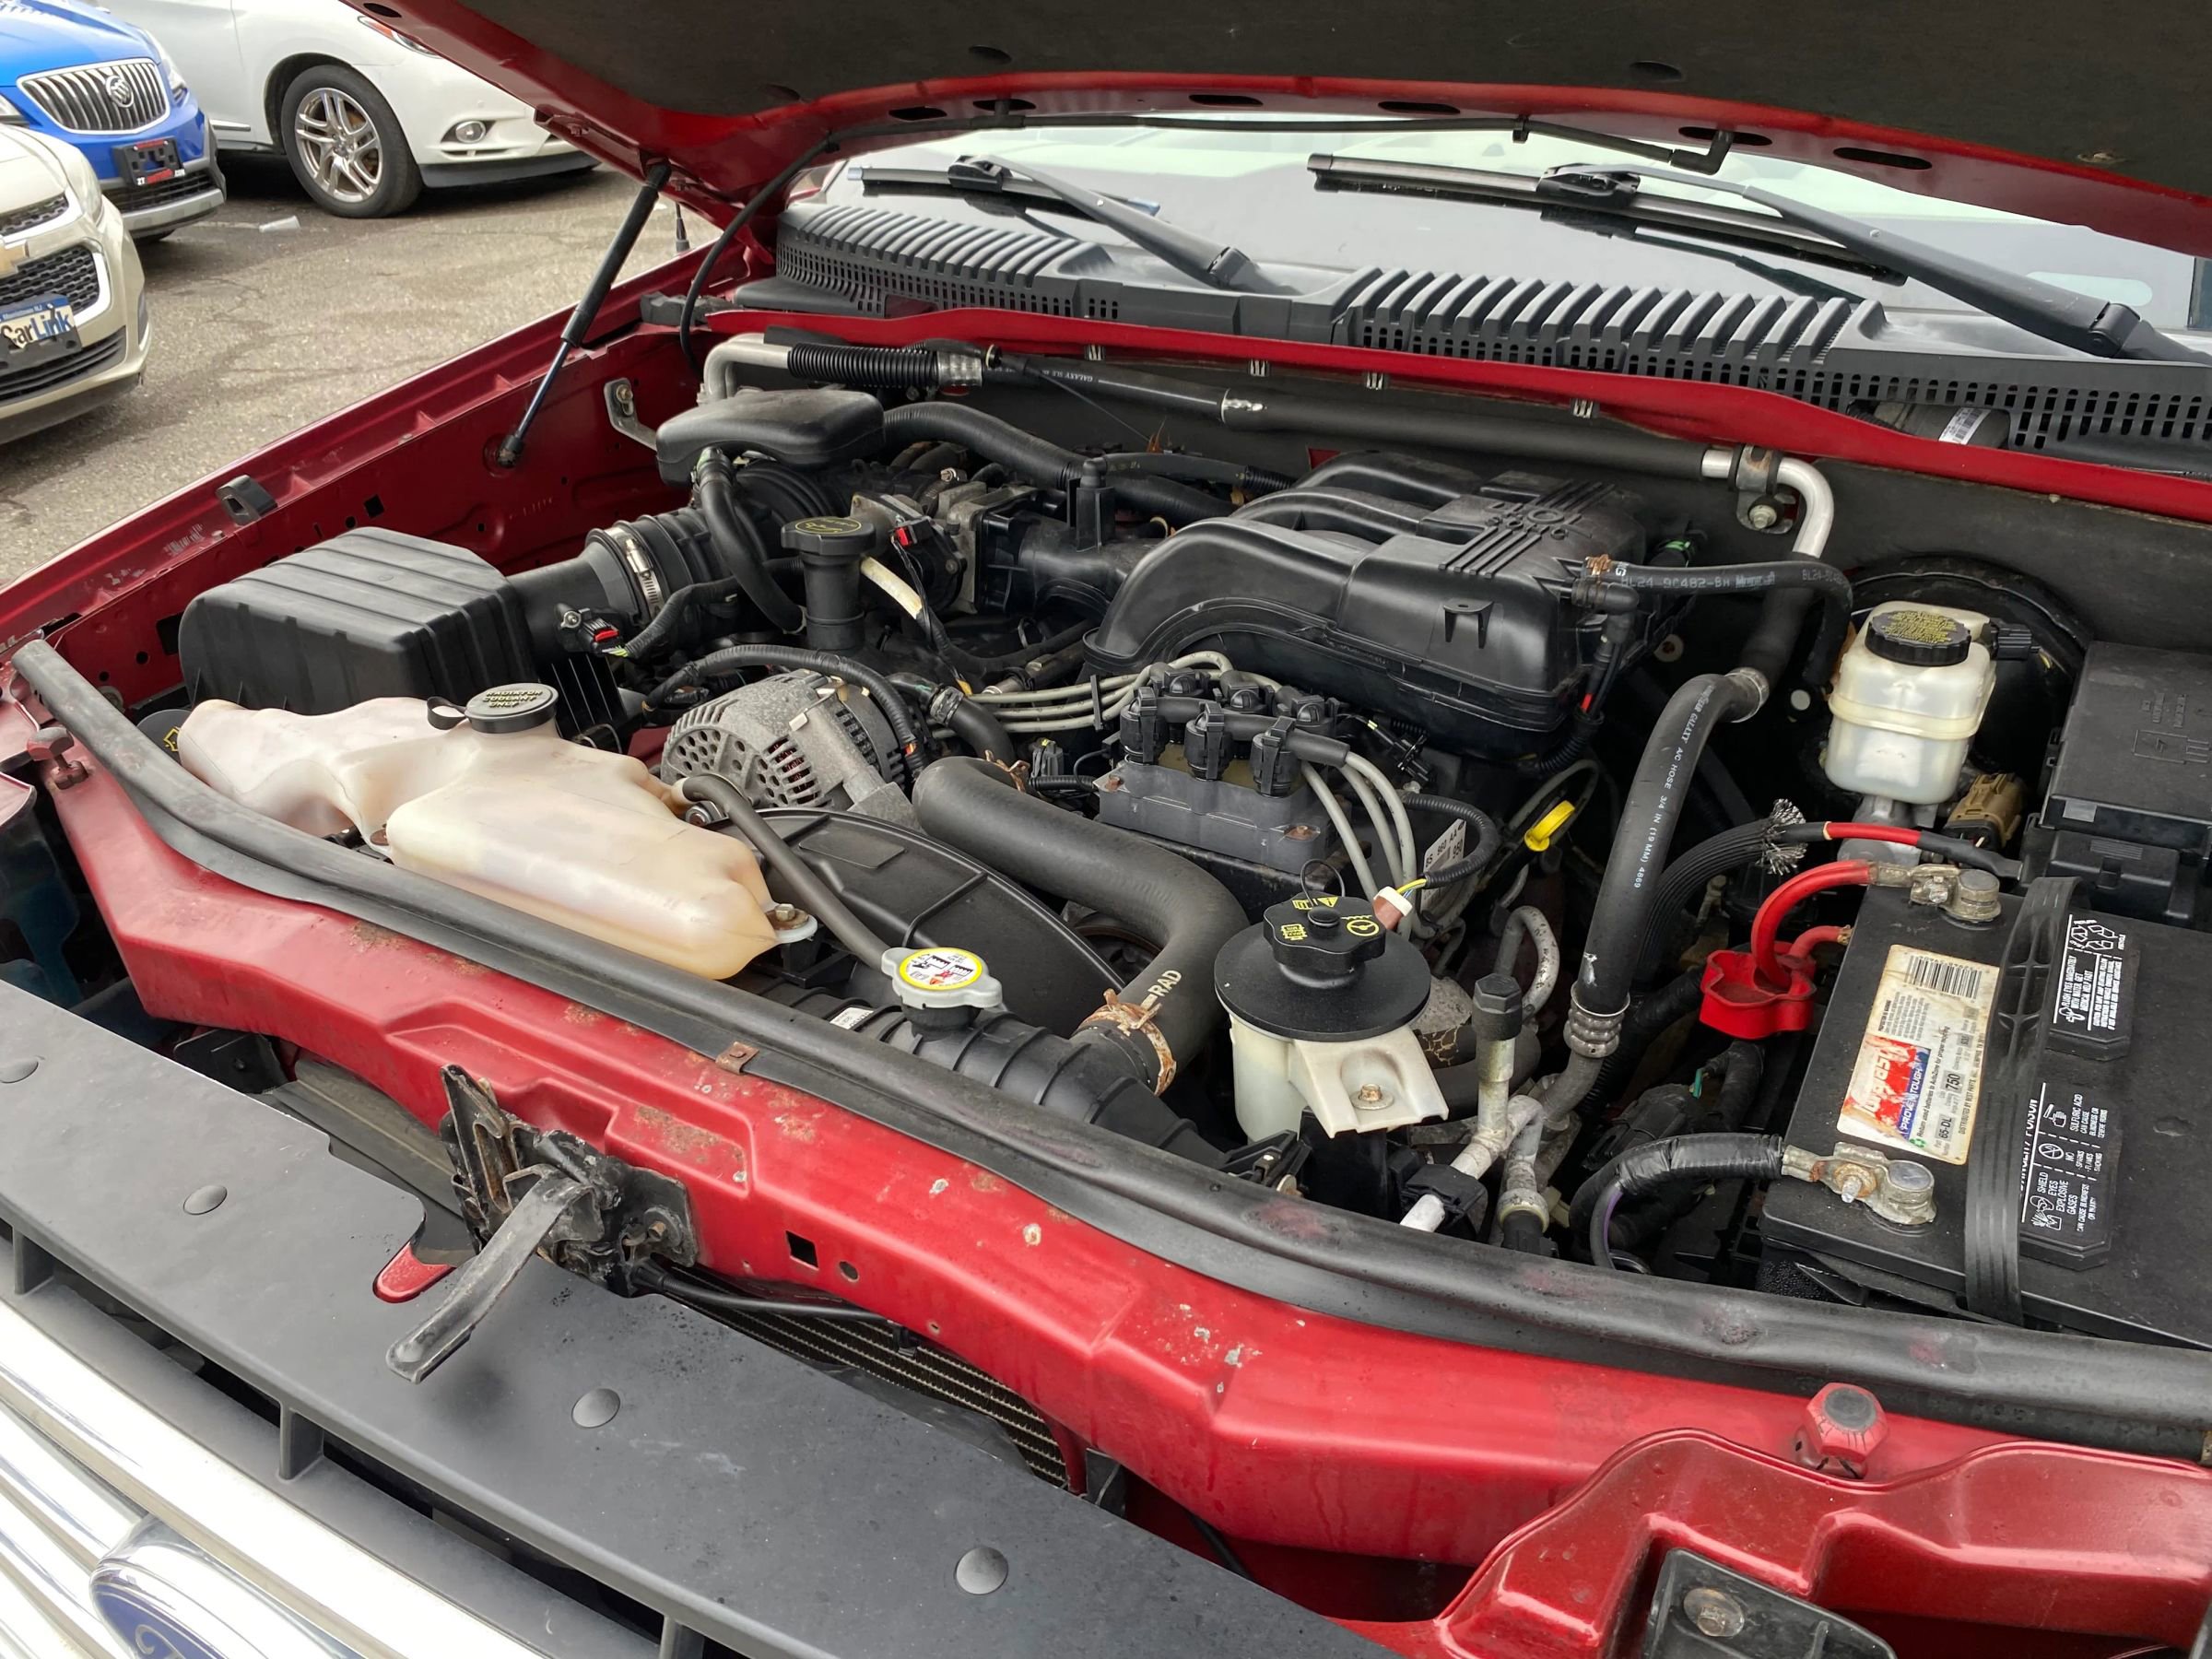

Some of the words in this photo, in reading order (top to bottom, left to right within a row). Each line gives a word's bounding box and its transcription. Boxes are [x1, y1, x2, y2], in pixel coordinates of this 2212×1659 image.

[1681, 712, 1698, 744] GALAXY
[1674, 747, 1683, 761] A/C
[1665, 763, 1677, 790] HOSE
[1658, 795, 1667, 809] 3/4
[1653, 813, 1663, 824] IN
[1648, 827, 1657, 842] (19
[1641, 843, 1653, 863] MM)
[1147, 970, 1182, 997] RAD
[1909, 1066, 1923, 1093] TOUGH
[1937, 1116, 1951, 1138] 65-DL
[1945, 1072, 1960, 1090] 750
[2072, 1093, 2083, 1107] ACID
[2069, 1106, 2081, 1131] SULFURIC
[2065, 1151, 2075, 1161] NO
[2036, 1171, 2048, 1193] SHIELD
[2047, 1180, 2058, 1195] EYES
[2054, 1180, 2069, 1212] EXPLOSIVE
[2065, 1194, 2078, 1215] GASES
